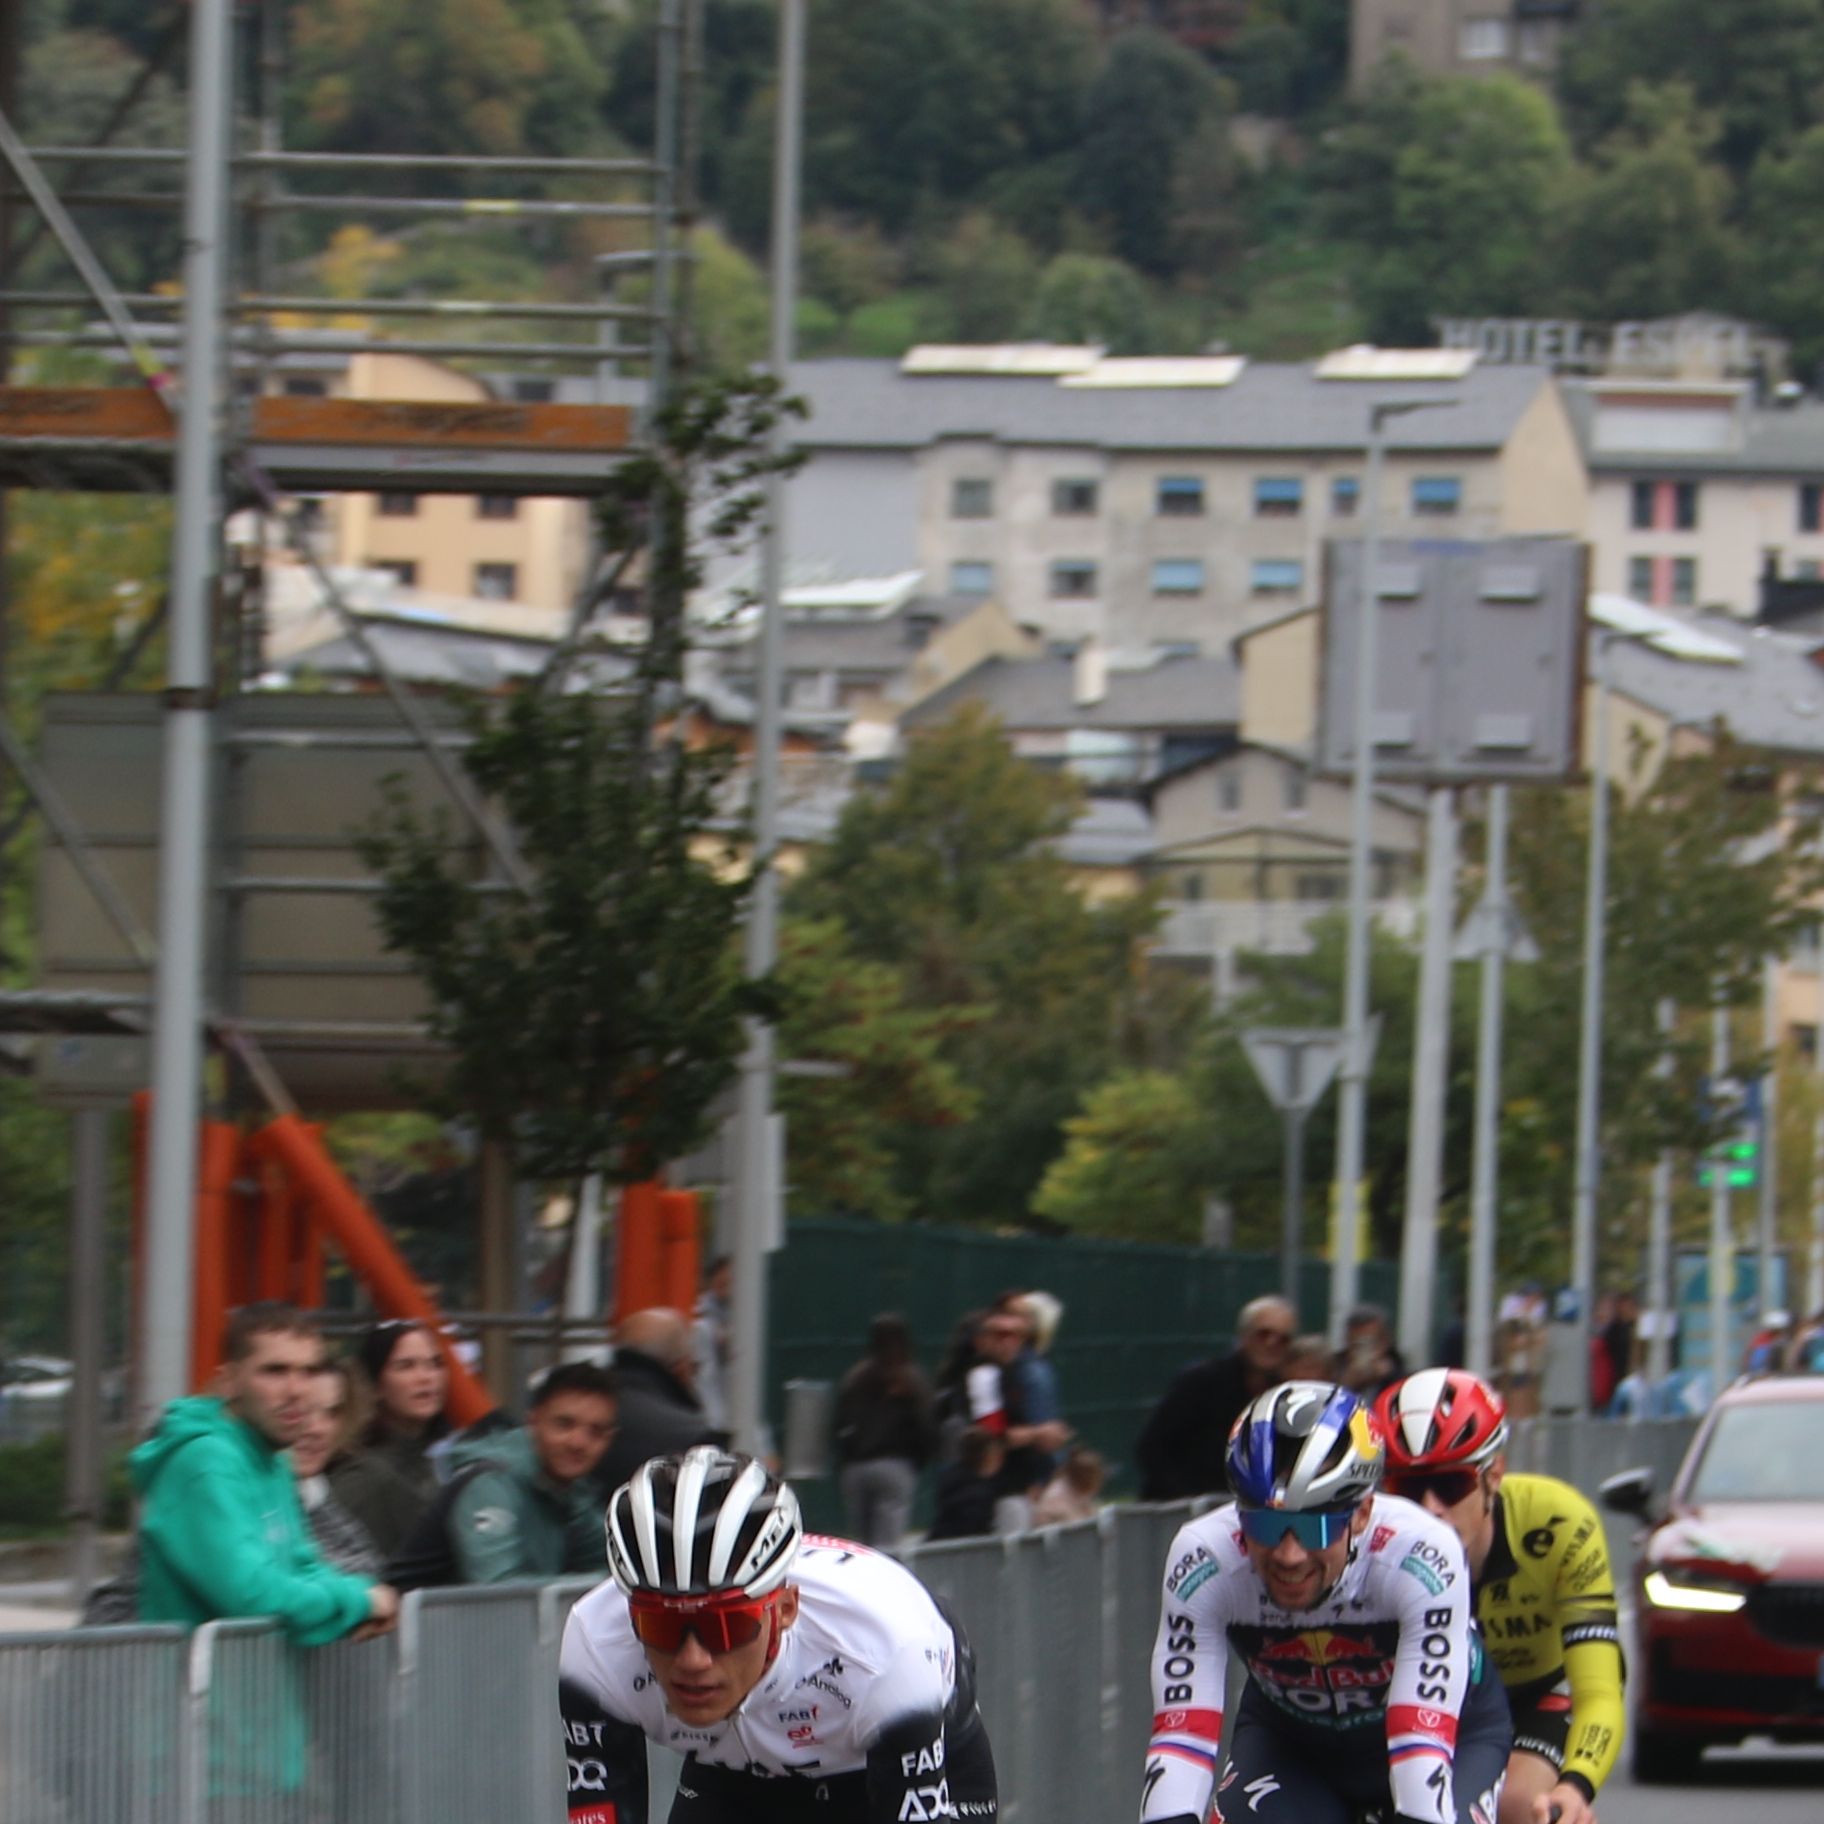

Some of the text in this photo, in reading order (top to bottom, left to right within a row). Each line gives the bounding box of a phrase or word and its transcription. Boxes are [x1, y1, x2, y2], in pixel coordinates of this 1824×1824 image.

[750, 1505, 789, 1570] MET
[1166, 1546, 1210, 1593] BORA
[1409, 1540, 1455, 1588] BORA
[1164, 1613, 1196, 1706] BOSS
[1327, 1656, 1396, 1692] Bul
[1416, 1607, 1453, 1705] BOSS
[900, 1728, 945, 1778] FAB
